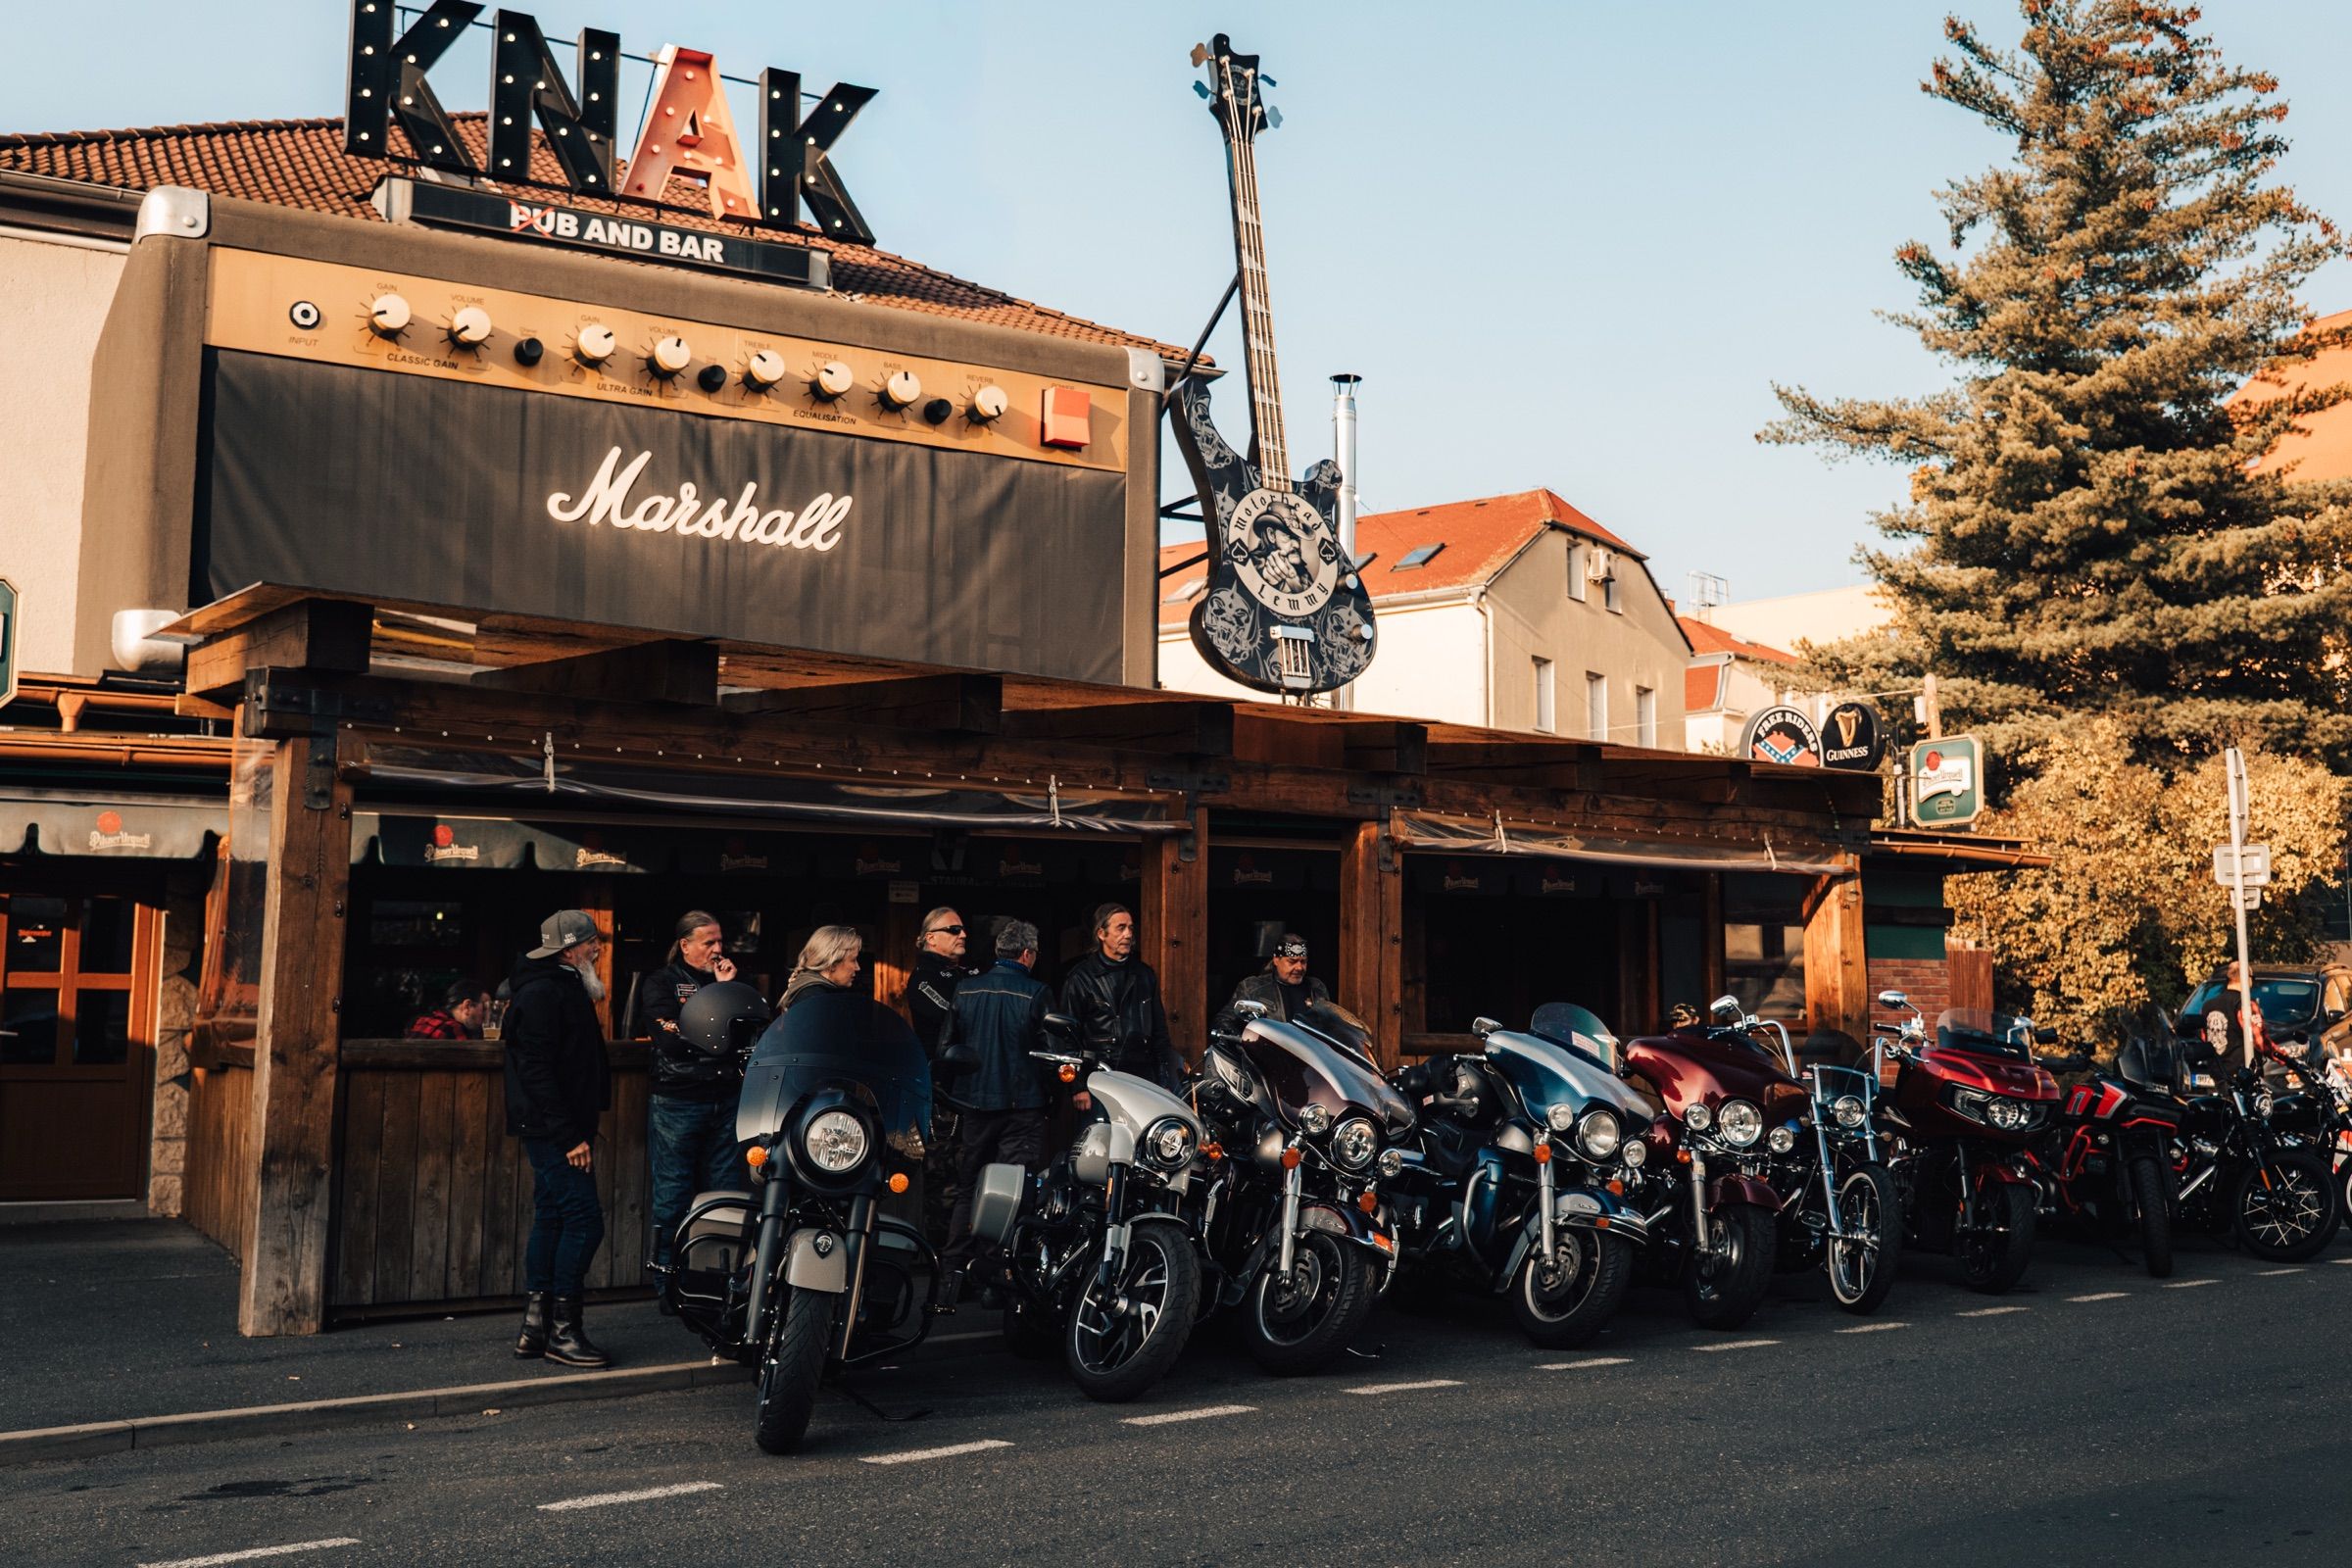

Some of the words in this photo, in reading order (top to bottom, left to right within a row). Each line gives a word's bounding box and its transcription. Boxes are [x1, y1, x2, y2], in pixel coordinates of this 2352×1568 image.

[344, 0, 880, 247] KNAK
[510, 204, 579, 238] PUB
[583, 218, 655, 251] AND
[660, 230, 725, 264] BAR
[375, 281, 398, 293] GAIN
[450, 293, 485, 307] VOLUME
[580, 314, 601, 324] GAIN
[648, 325, 679, 337] VOLUME
[288, 335, 319, 348] INPUT
[744, 339, 771, 351] TREBLE
[386, 352, 431, 368] CLASSIC
[433, 358, 460, 371] GAIN
[811, 350, 839, 362] MIDDLE
[883, 361, 903, 371] BASS
[966, 373, 995, 385] REVERB
[596, 381, 628, 394] ULTRA
[629, 385, 654, 398] GAIN
[792, 409, 858, 426] EQUALISATION
[546, 445, 854, 552] Marshall
[1257, 582, 1329, 612] Lemmy
[1757, 711, 1784, 738] FREE
[1785, 711, 1819, 753] RIDERS
[1826, 745, 1869, 762] GUINNESS
